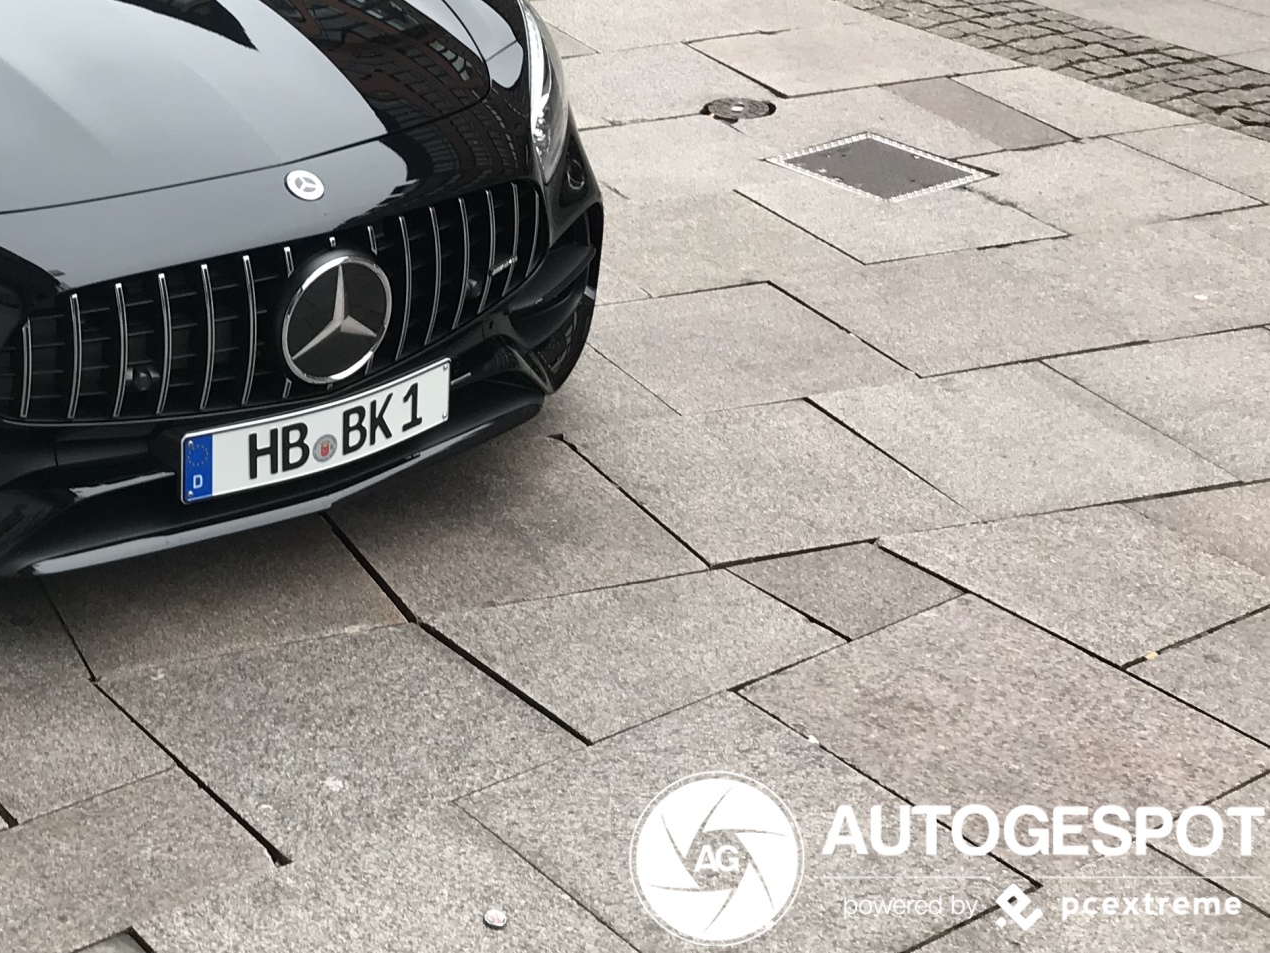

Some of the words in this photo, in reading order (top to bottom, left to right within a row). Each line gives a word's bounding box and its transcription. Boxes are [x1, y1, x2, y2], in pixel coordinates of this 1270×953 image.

[248, 422, 310, 480] HB
[342, 392, 393, 456] BK
[401, 382, 423, 433] 1
[193, 474, 203, 489] D
